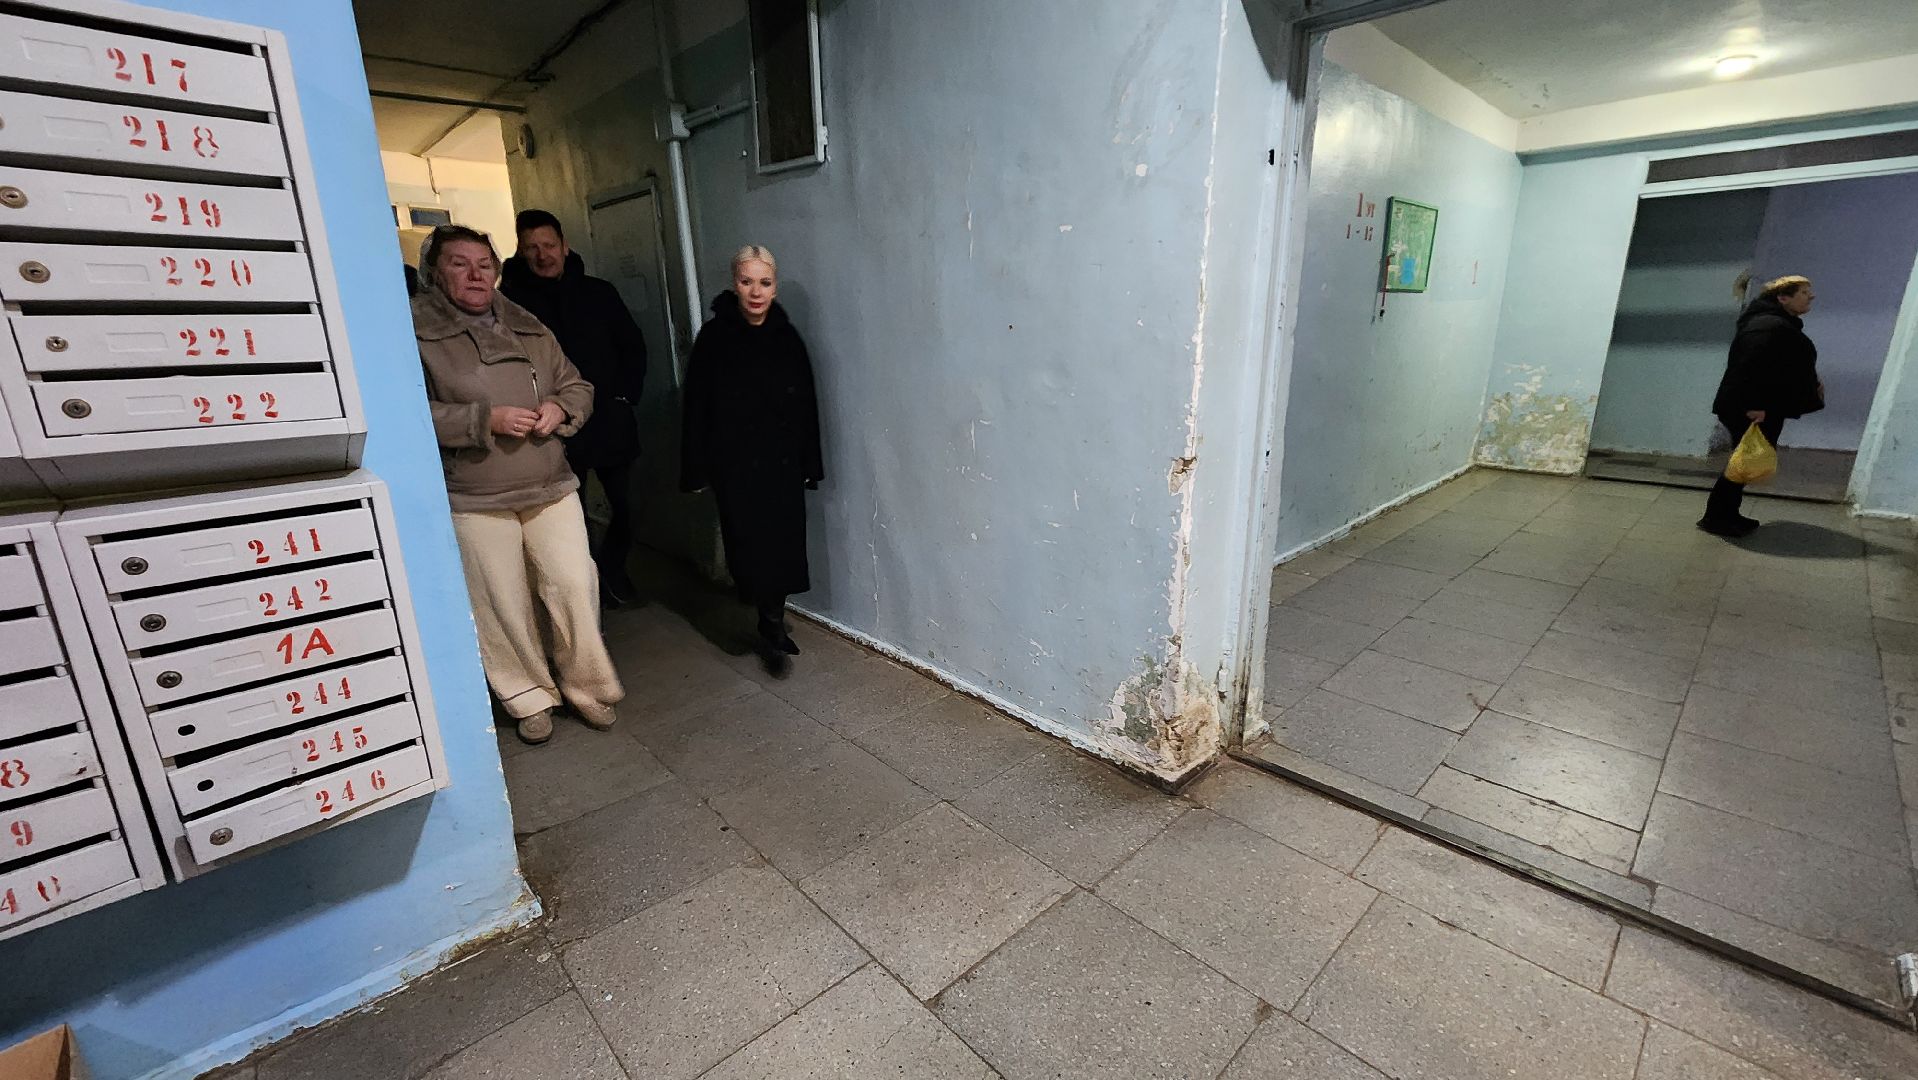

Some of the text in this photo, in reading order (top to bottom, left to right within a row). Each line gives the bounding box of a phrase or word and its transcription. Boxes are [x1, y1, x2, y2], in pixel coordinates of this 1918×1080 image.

[107, 47, 188, 92] 217
[123, 115, 220, 159] 218
[145, 193, 222, 228] 219
[160, 256, 252, 288] 220
[179, 327, 257, 357] 221
[193, 391, 280, 424] 222
[247, 528, 322, 564] 241
[258, 578, 332, 616] 242
[286, 677, 353, 715] 244
[302, 726, 369, 762] 245
[0, 759, 31, 789] 8
[315, 769, 387, 813] 246
[10, 820, 33, 847] 9
